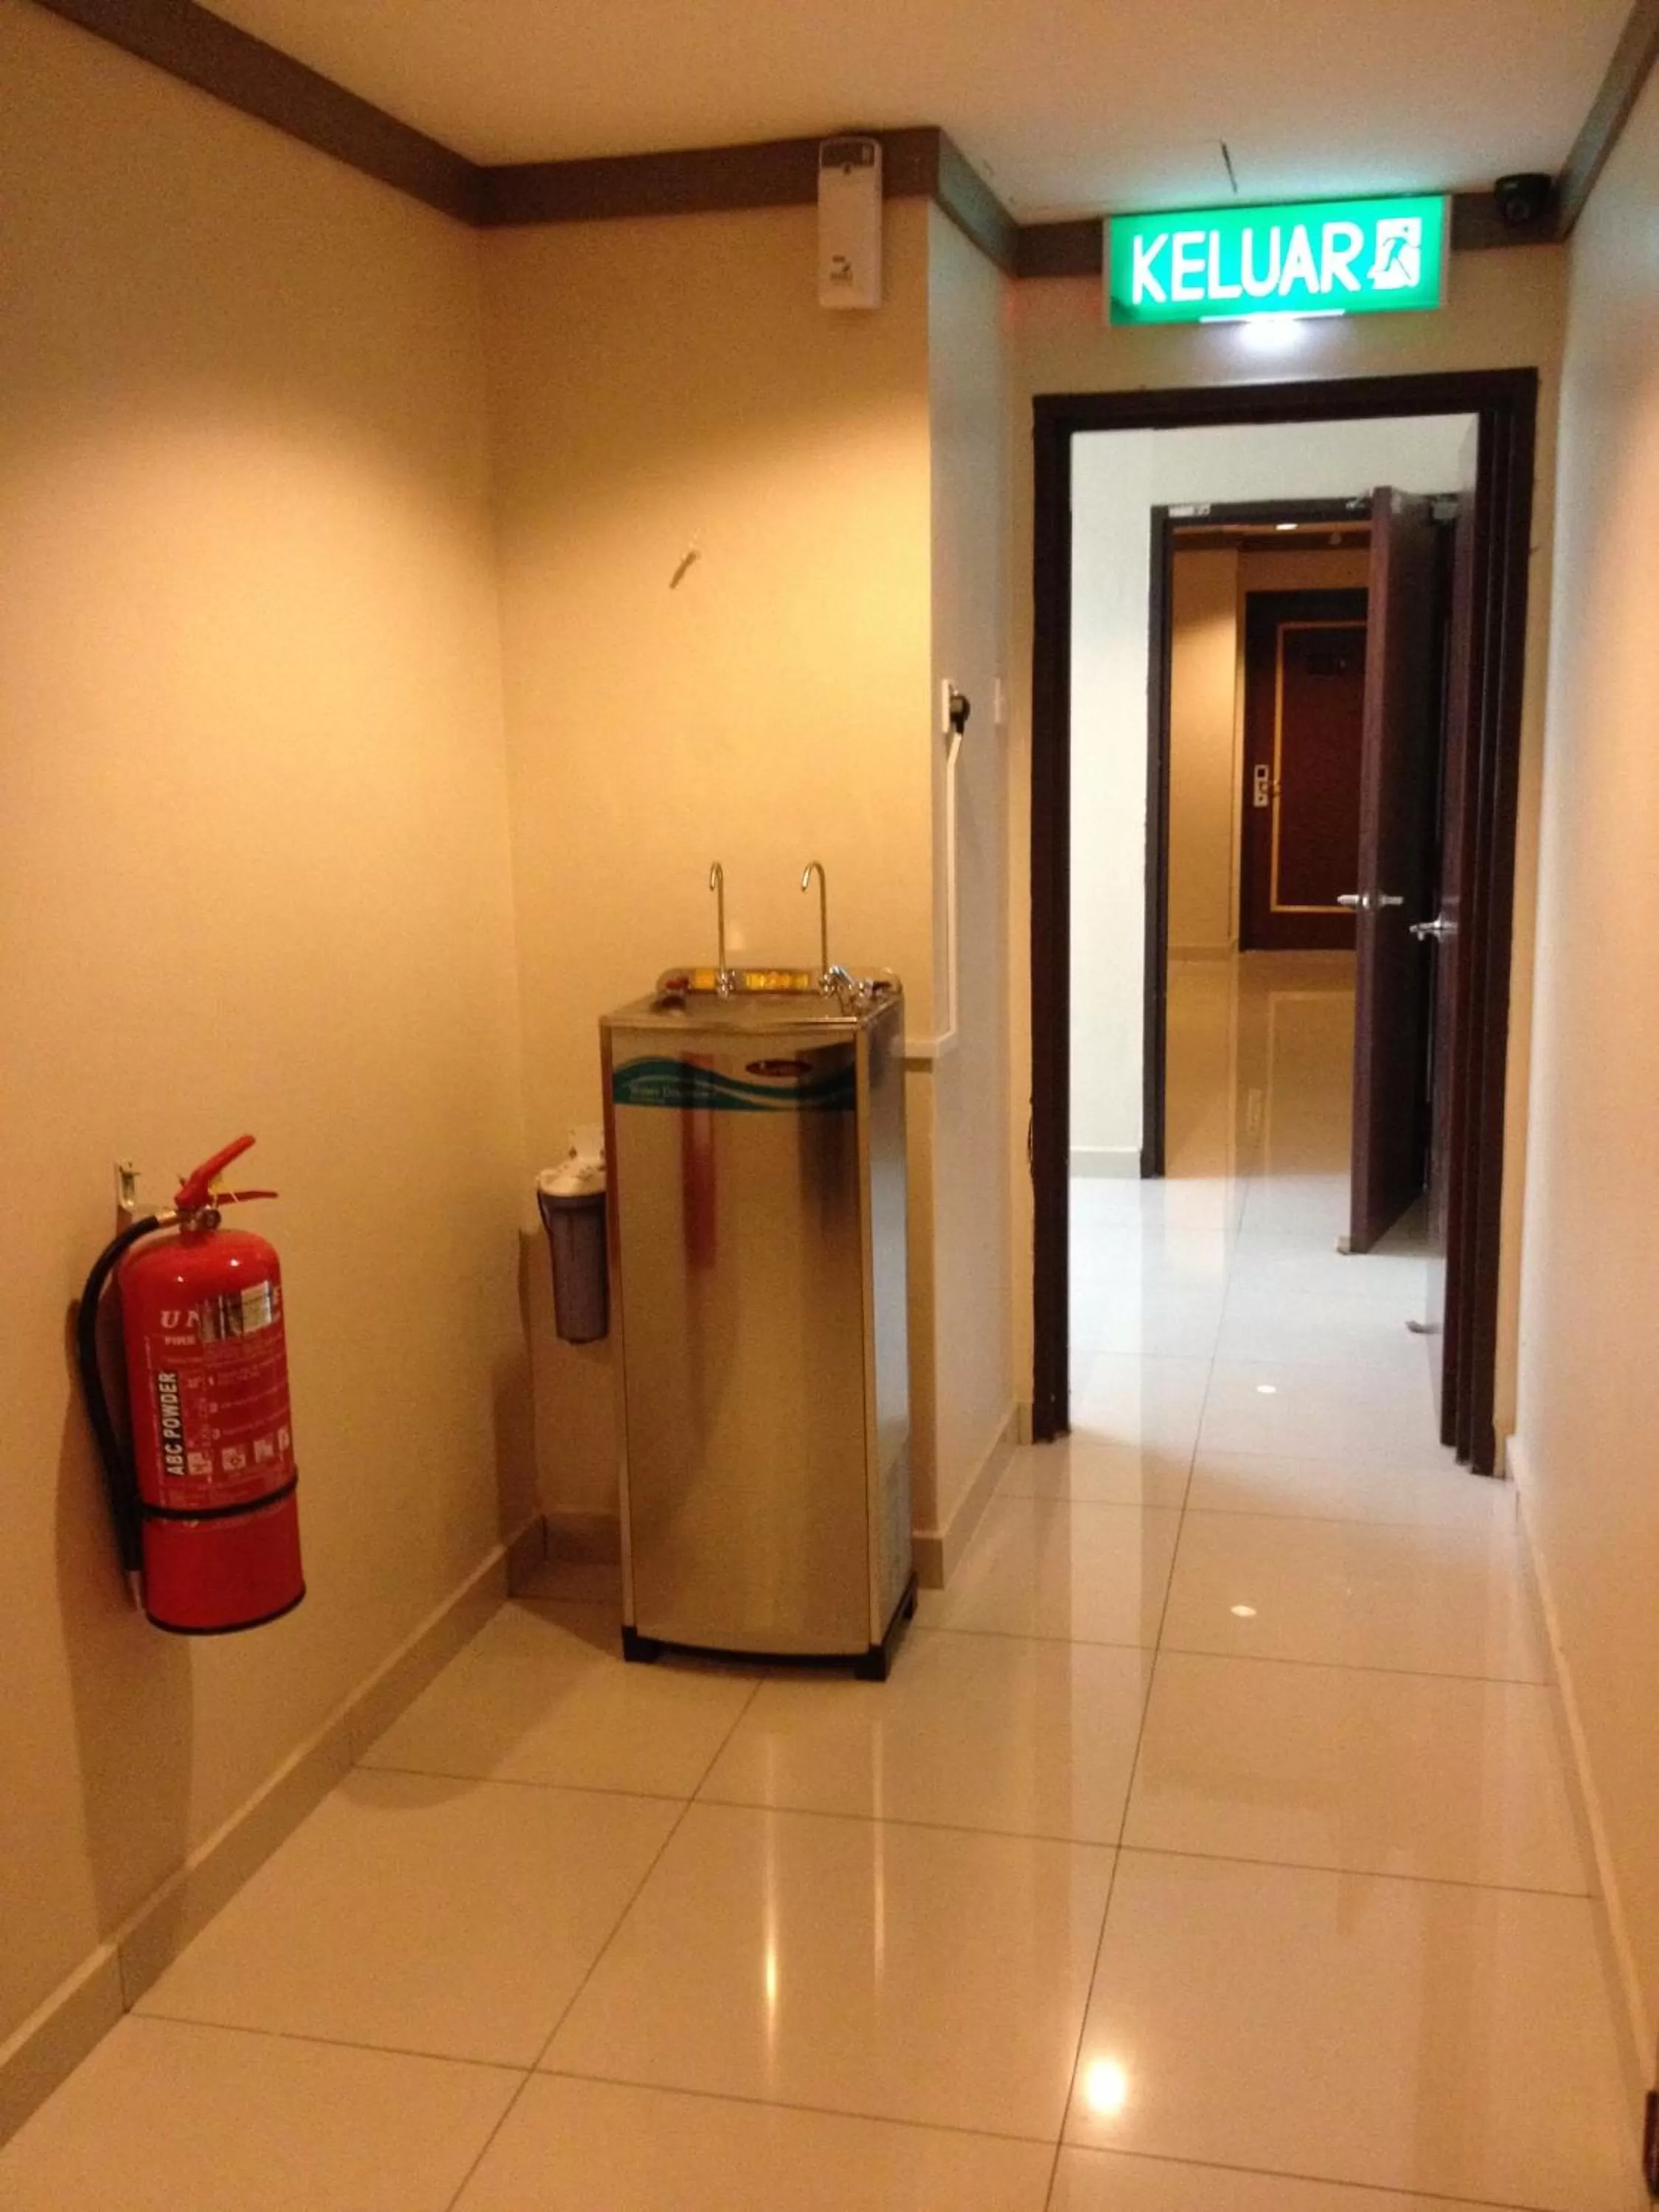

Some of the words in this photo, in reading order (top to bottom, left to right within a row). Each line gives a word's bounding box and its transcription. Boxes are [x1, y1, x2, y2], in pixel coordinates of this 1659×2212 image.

[1133, 222, 1363, 304] KELUAR
[159, 1372, 181, 1439] POWDER
[165, 1444, 184, 1475] ABC
